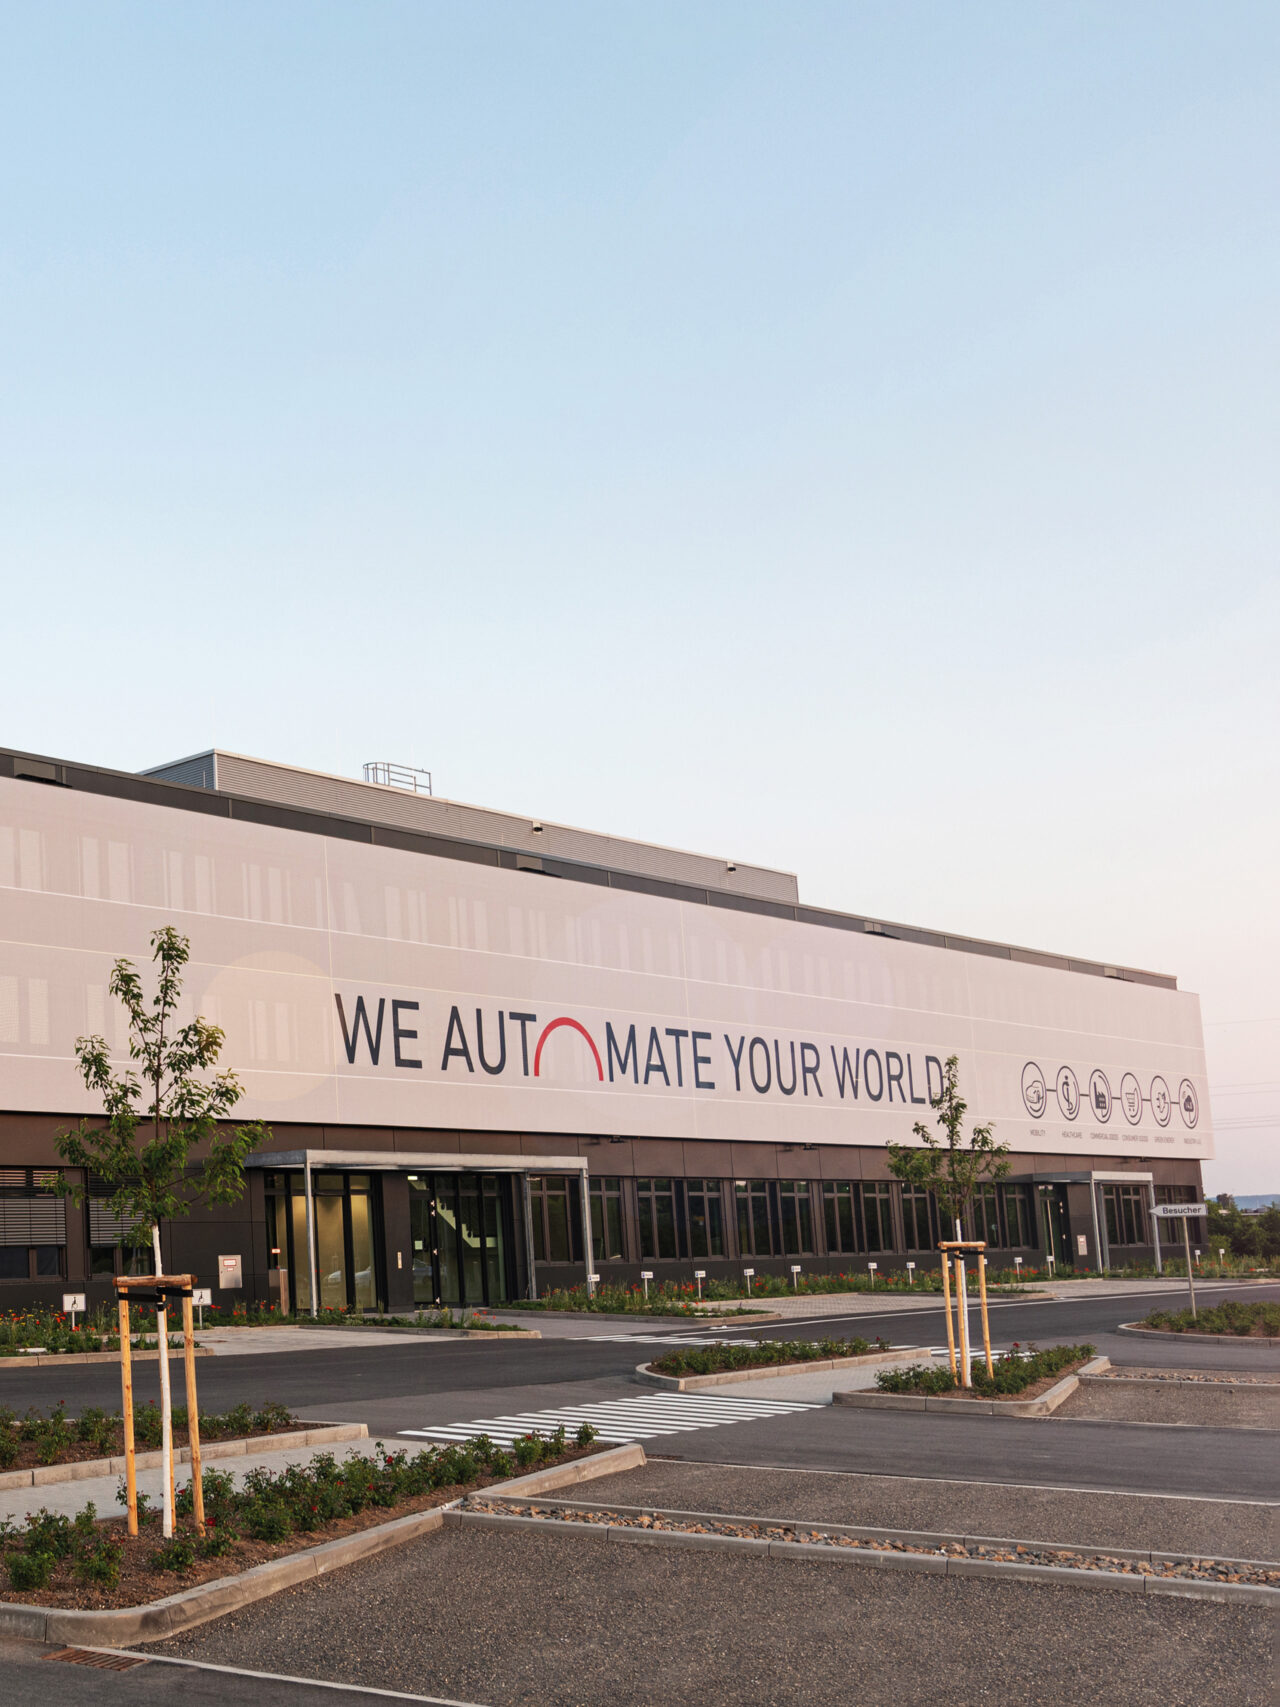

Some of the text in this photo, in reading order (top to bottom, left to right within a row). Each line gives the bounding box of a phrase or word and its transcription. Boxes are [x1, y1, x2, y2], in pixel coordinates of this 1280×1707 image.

[334, 993, 423, 1069] WE
[723, 1034, 824, 1098] YOUR
[830, 1044, 945, 1105] WORLD
[1162, 1206, 1202, 1215] Besucher
